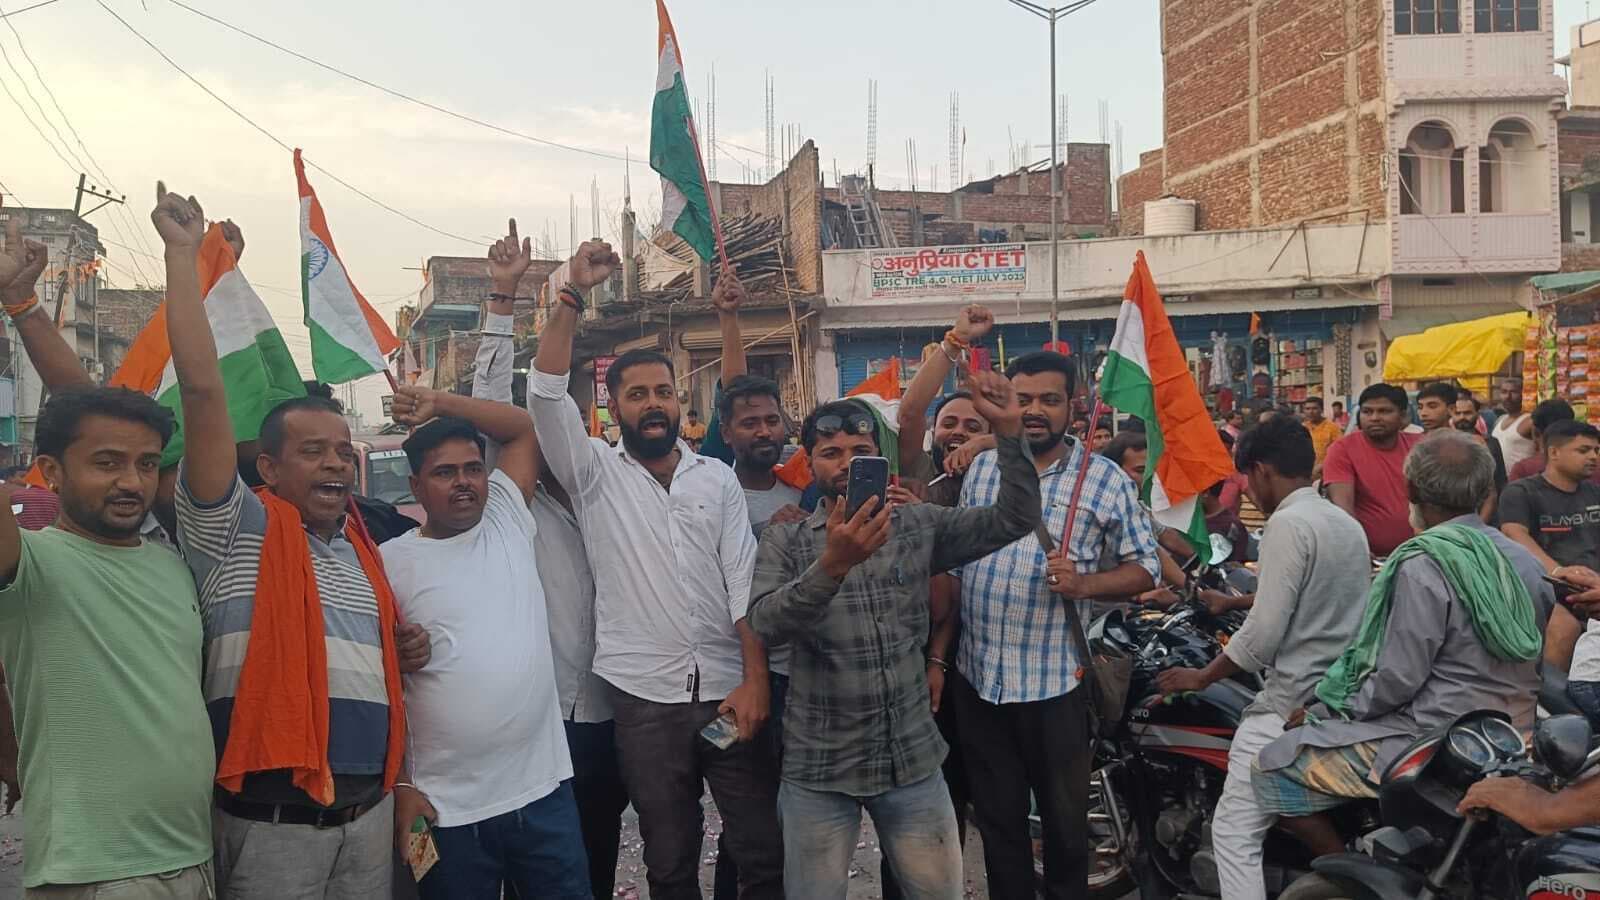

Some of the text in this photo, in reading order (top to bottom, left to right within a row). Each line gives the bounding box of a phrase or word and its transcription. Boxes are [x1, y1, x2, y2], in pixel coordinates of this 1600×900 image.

[883, 249, 1025, 276] अनुप्रिया CTET
[873, 278, 901, 288] BPSC
[904, 276, 925, 286] TRE
[951, 275, 974, 284] CTET
[976, 273, 1000, 283] JULY
[1538, 875, 1586, 900] Hero
